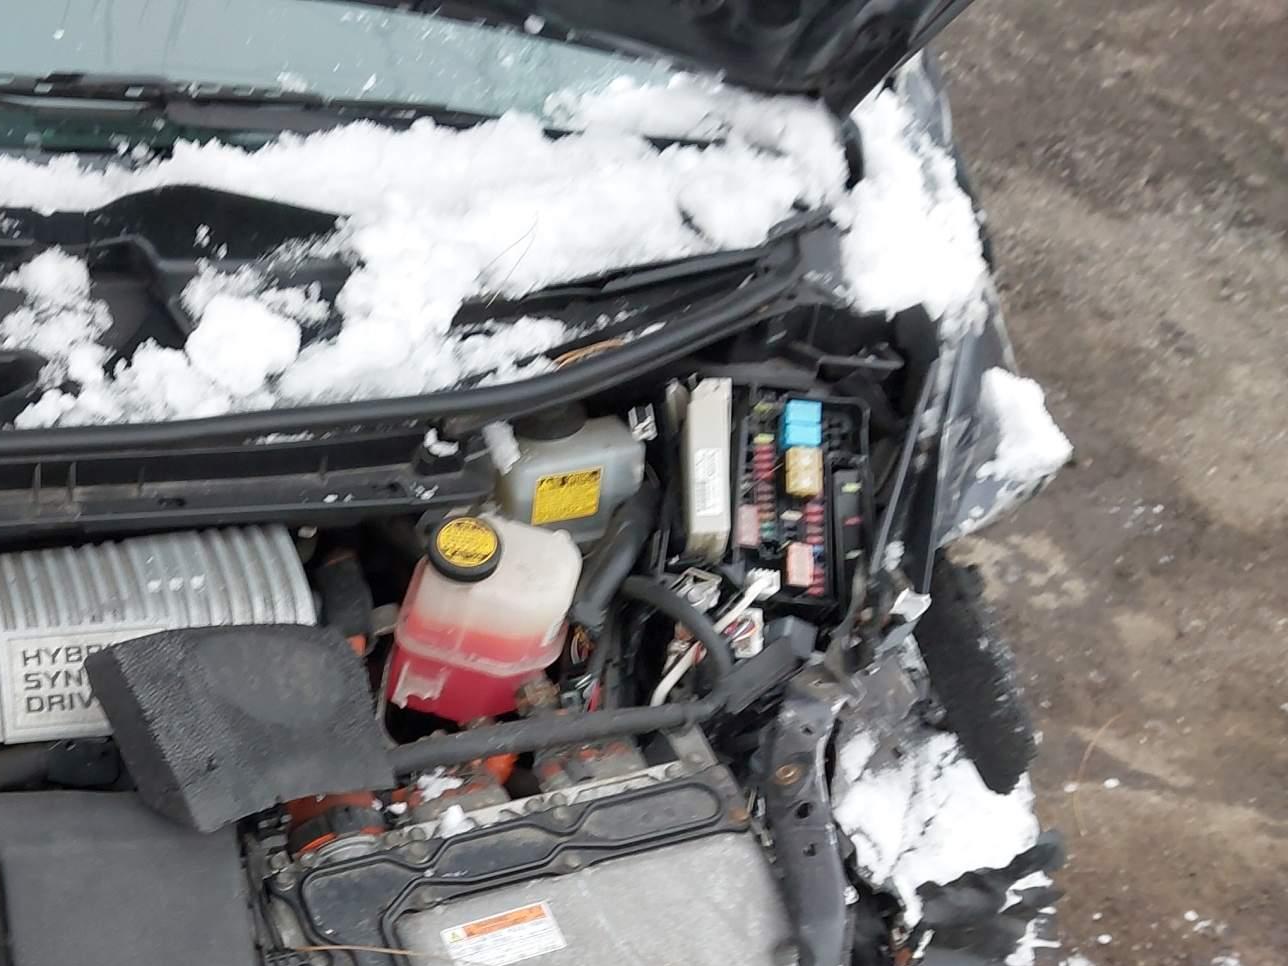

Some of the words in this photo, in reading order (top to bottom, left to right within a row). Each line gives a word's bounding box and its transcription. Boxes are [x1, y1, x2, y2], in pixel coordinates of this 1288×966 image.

[22, 644, 102, 666] HYBR
[24, 670, 83, 691] SYN
[26, 692, 93, 713] DRIV
